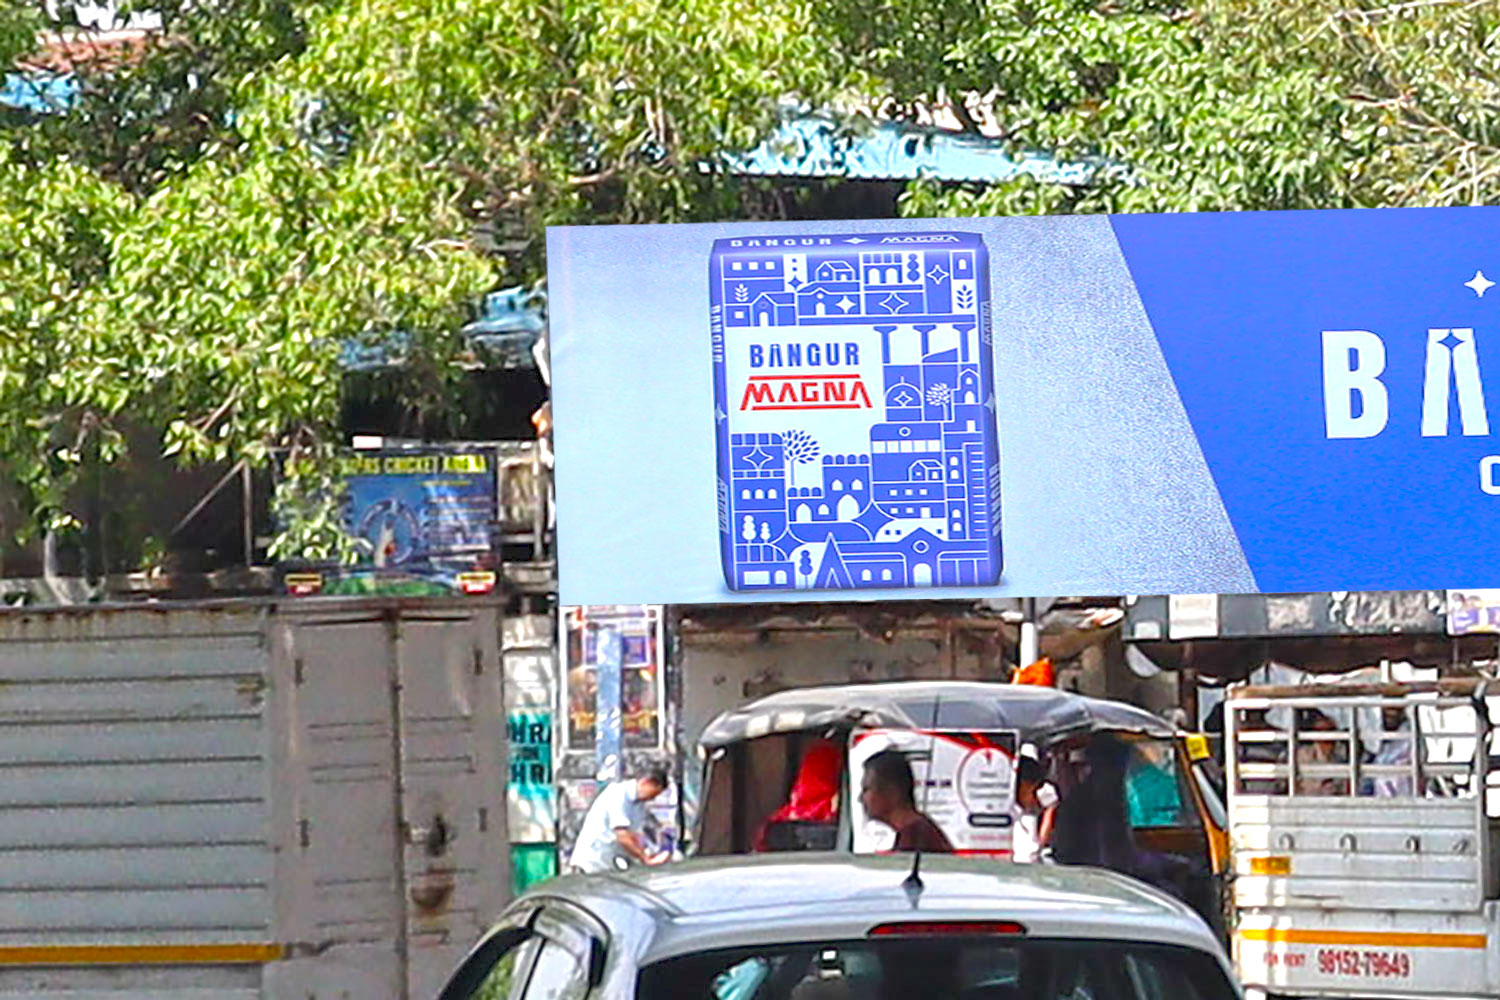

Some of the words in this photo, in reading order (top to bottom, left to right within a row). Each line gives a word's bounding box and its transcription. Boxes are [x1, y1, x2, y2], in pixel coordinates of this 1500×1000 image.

[730, 237, 831, 247] BANGUR
[880, 235, 960, 243] MAGNA
[749, 342, 861, 368] BANGUR
[739, 374, 875, 411] MAGNA
